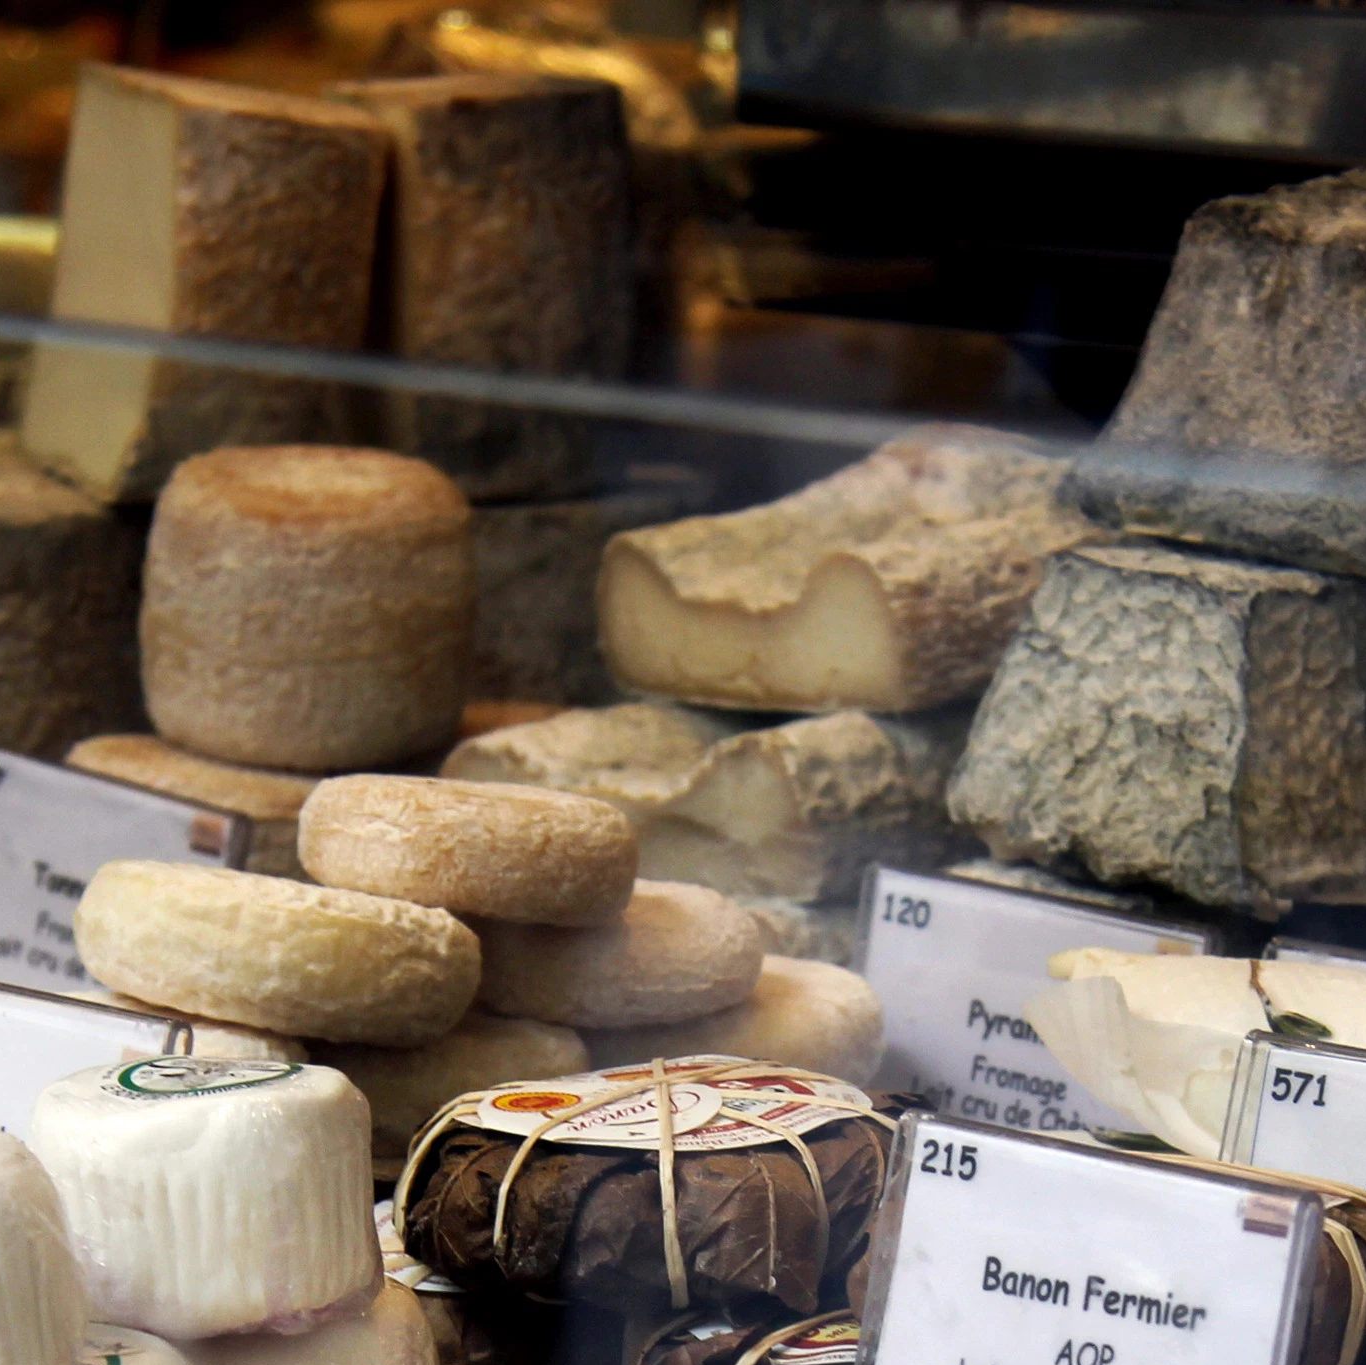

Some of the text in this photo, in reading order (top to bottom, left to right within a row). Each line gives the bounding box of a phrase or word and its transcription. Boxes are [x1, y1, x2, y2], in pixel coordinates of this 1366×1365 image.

[882, 894, 931, 928] 120
[970, 1054, 1067, 1105] Fromage
[1271, 1067, 1326, 1106] 571
[1004, 1099, 1031, 1127] de
[919, 1140, 978, 1181] 215
[982, 1256, 1208, 1331] Banon Fermier
